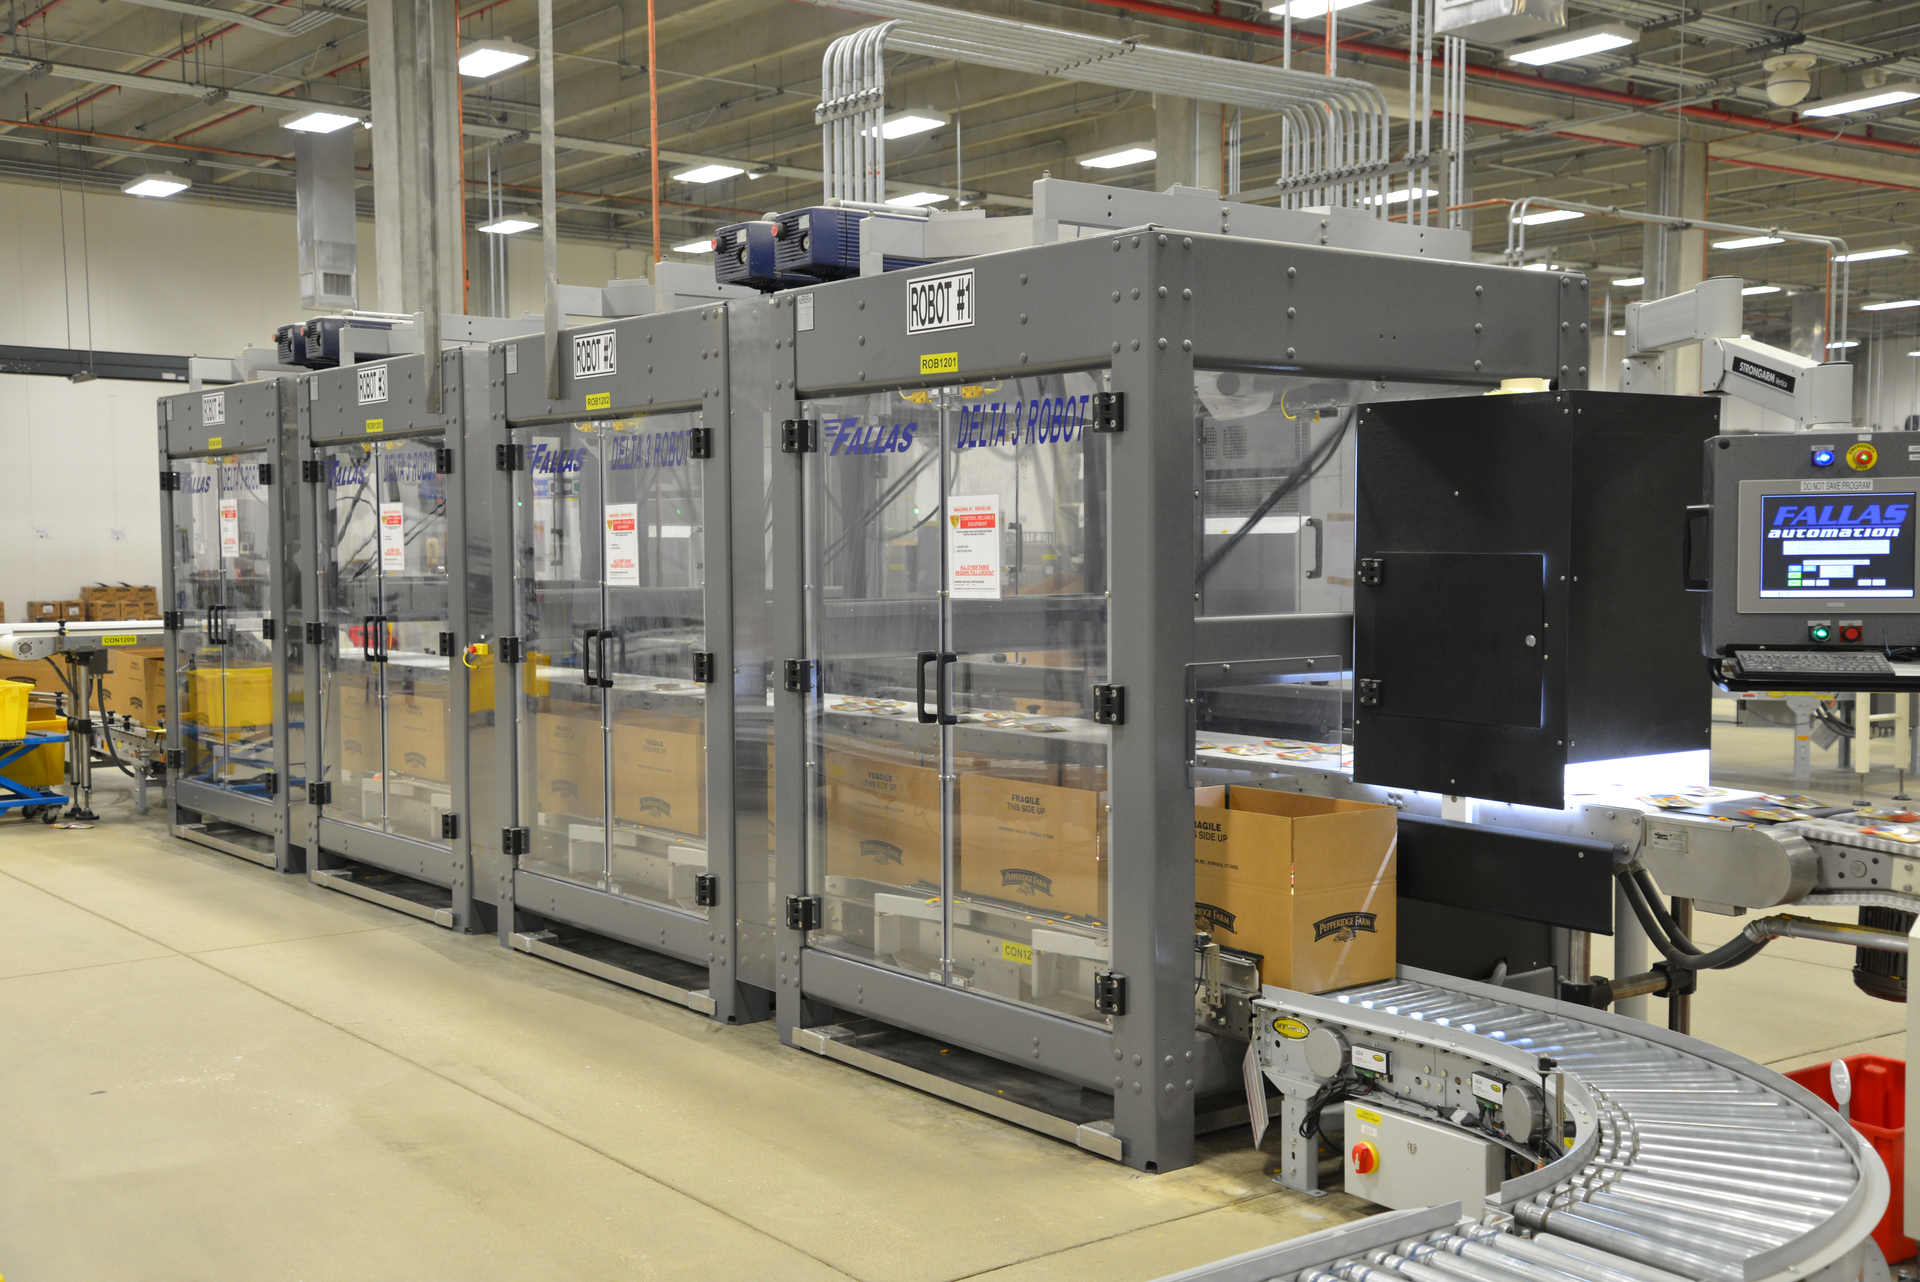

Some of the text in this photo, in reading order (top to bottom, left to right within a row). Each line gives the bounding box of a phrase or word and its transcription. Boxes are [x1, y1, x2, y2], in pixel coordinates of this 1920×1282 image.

[911, 277, 971, 327] ROBOT #1
[576, 336, 614, 373] ROBOT #2
[922, 357, 957, 369] ROB1201
[1739, 362, 1776, 384] STRONGARM
[360, 369, 386, 400] ROBOT #3
[203, 397, 217, 422] ROBOT
[587, 396, 610, 406] ROB1202
[957, 394, 1090, 449] DELTA 3 ROBOT
[824, 417, 917, 456] FALLAS
[526, 443, 586, 475] FALLAS
[611, 434, 642, 471] DELTA
[644, 433, 651, 469] 3
[244, 464, 261, 490] ROBO
[325, 460, 367, 486] FALLAS
[383, 453, 404, 483] DELTA
[1803, 481, 1872, 491] DO NOT SAVE PROGRAM
[1772, 504, 1909, 526] FALLAS
[1767, 527, 1901, 539] automation
[104, 636, 135, 644] CON1209
[864, 779, 876, 788] THIS
[876, 780, 889, 790] SIDE
[868, 771, 893, 782] FRAGILE
[1006, 802, 1046, 816] THIS SIDE UP
[1011, 794, 1040, 806] FRAGILE
[1195, 820, 1222, 832] RAGILE
[1198, 831, 1216, 842] SIDE
[1217, 834, 1228, 843] UP
[1195, 907, 1230, 926] RIDGE FARM
[1319, 915, 1371, 935] PEPPERIDGE FARM
